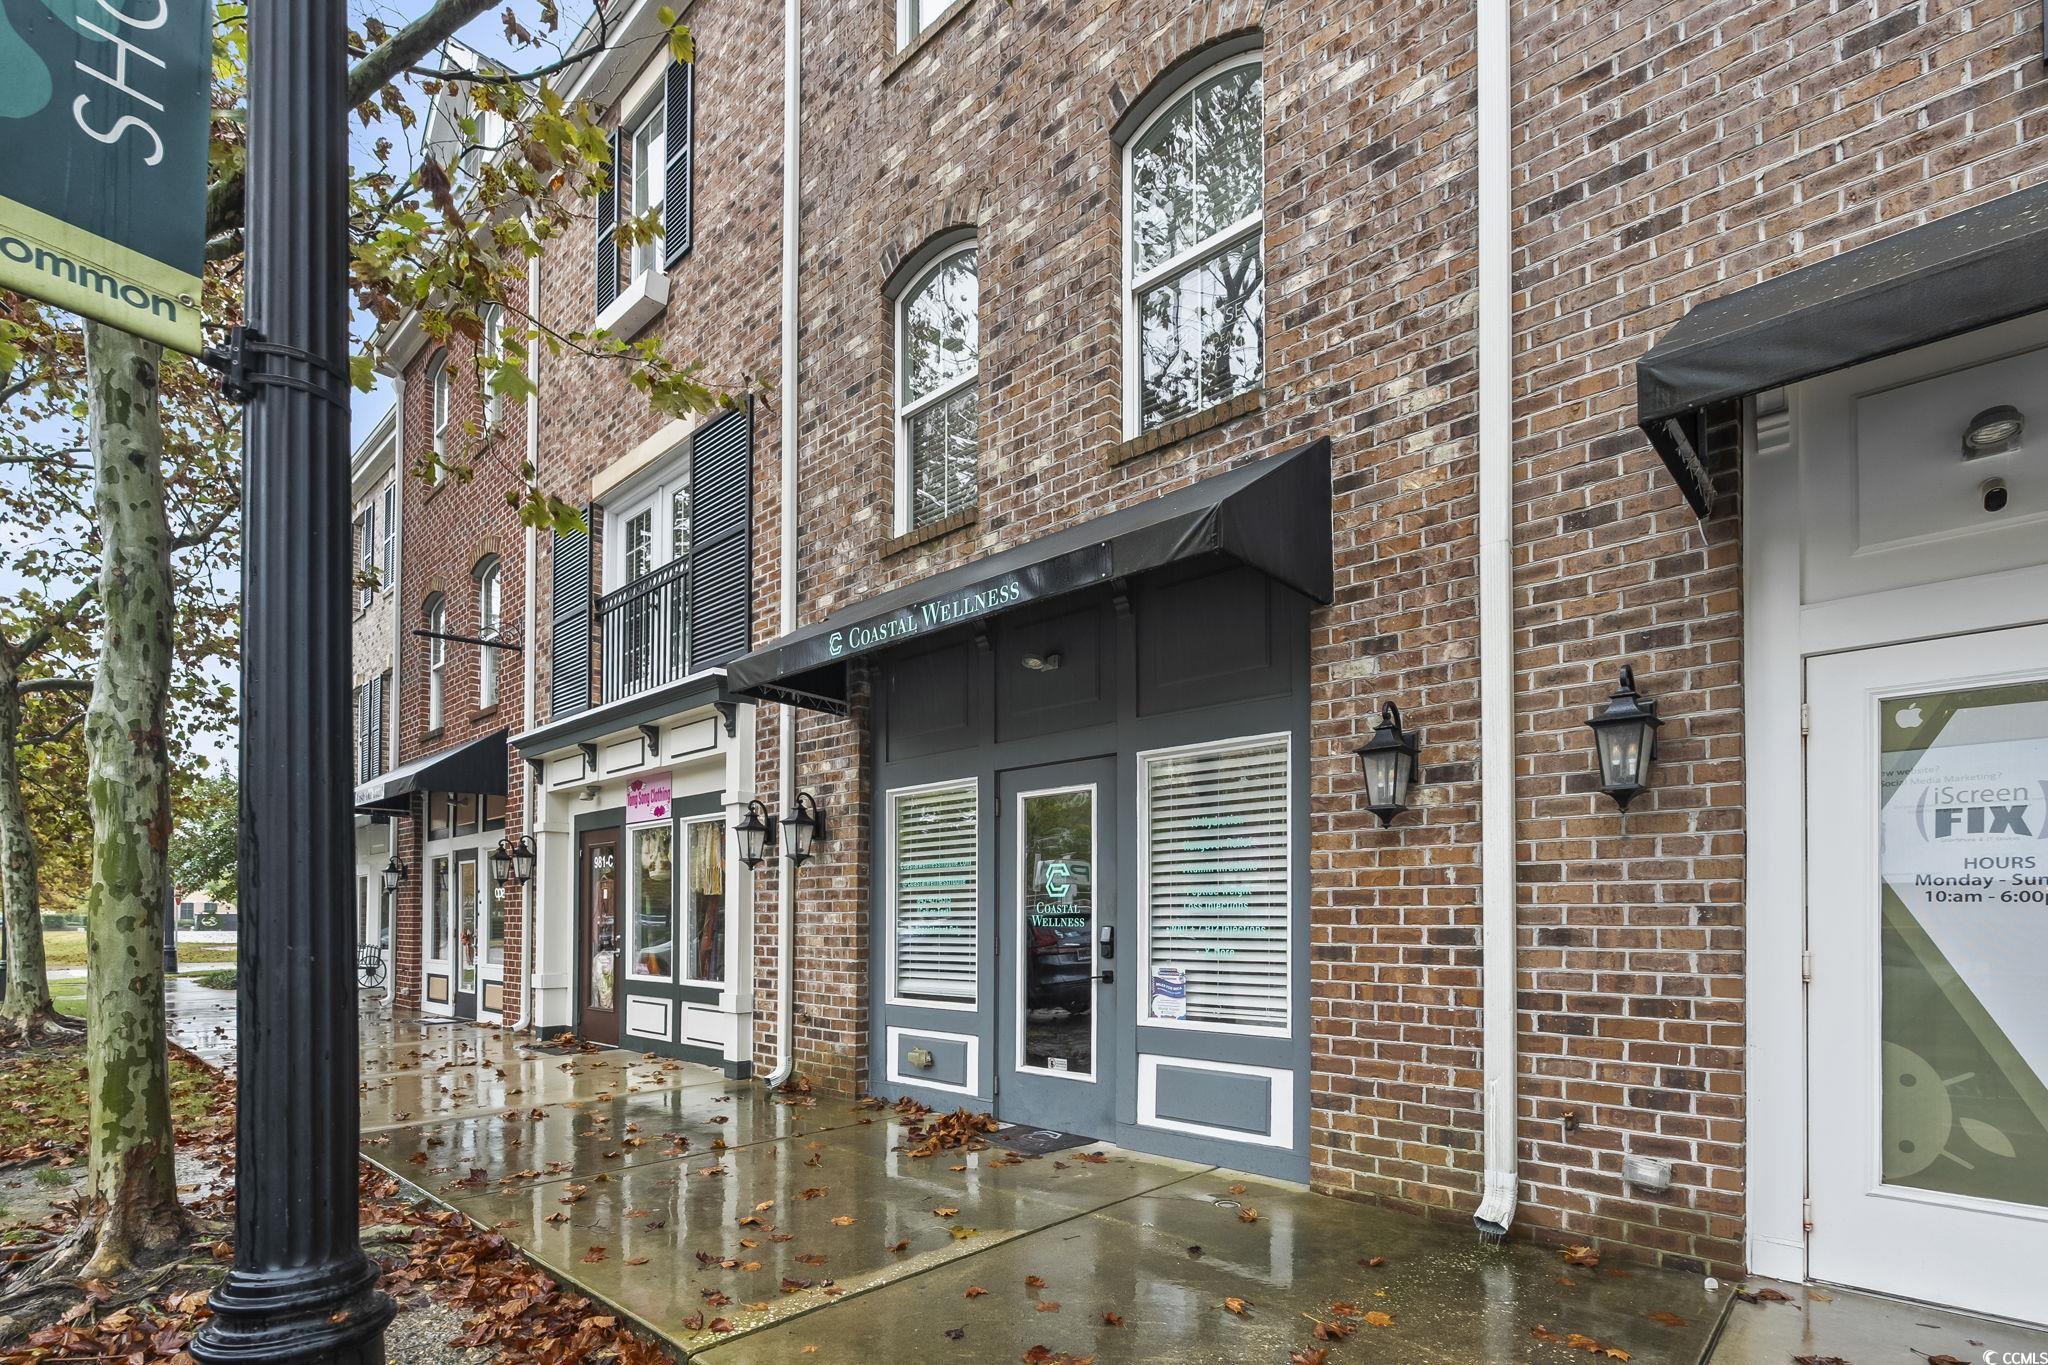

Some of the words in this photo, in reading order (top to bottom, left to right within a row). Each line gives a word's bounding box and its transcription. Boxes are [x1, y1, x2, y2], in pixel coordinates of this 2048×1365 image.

[1, 236, 177, 322] ommon
[651, 786, 671, 804] Clothing
[1934, 786, 2028, 804] iScreen
[1935, 804, 2032, 838] FIX
[1963, 856, 2036, 869] HOURS
[1915, 873, 1994, 889] Monday
[1925, 890, 1983, 903] 10:am
[2000, 890, 2048, 906] 6:00
